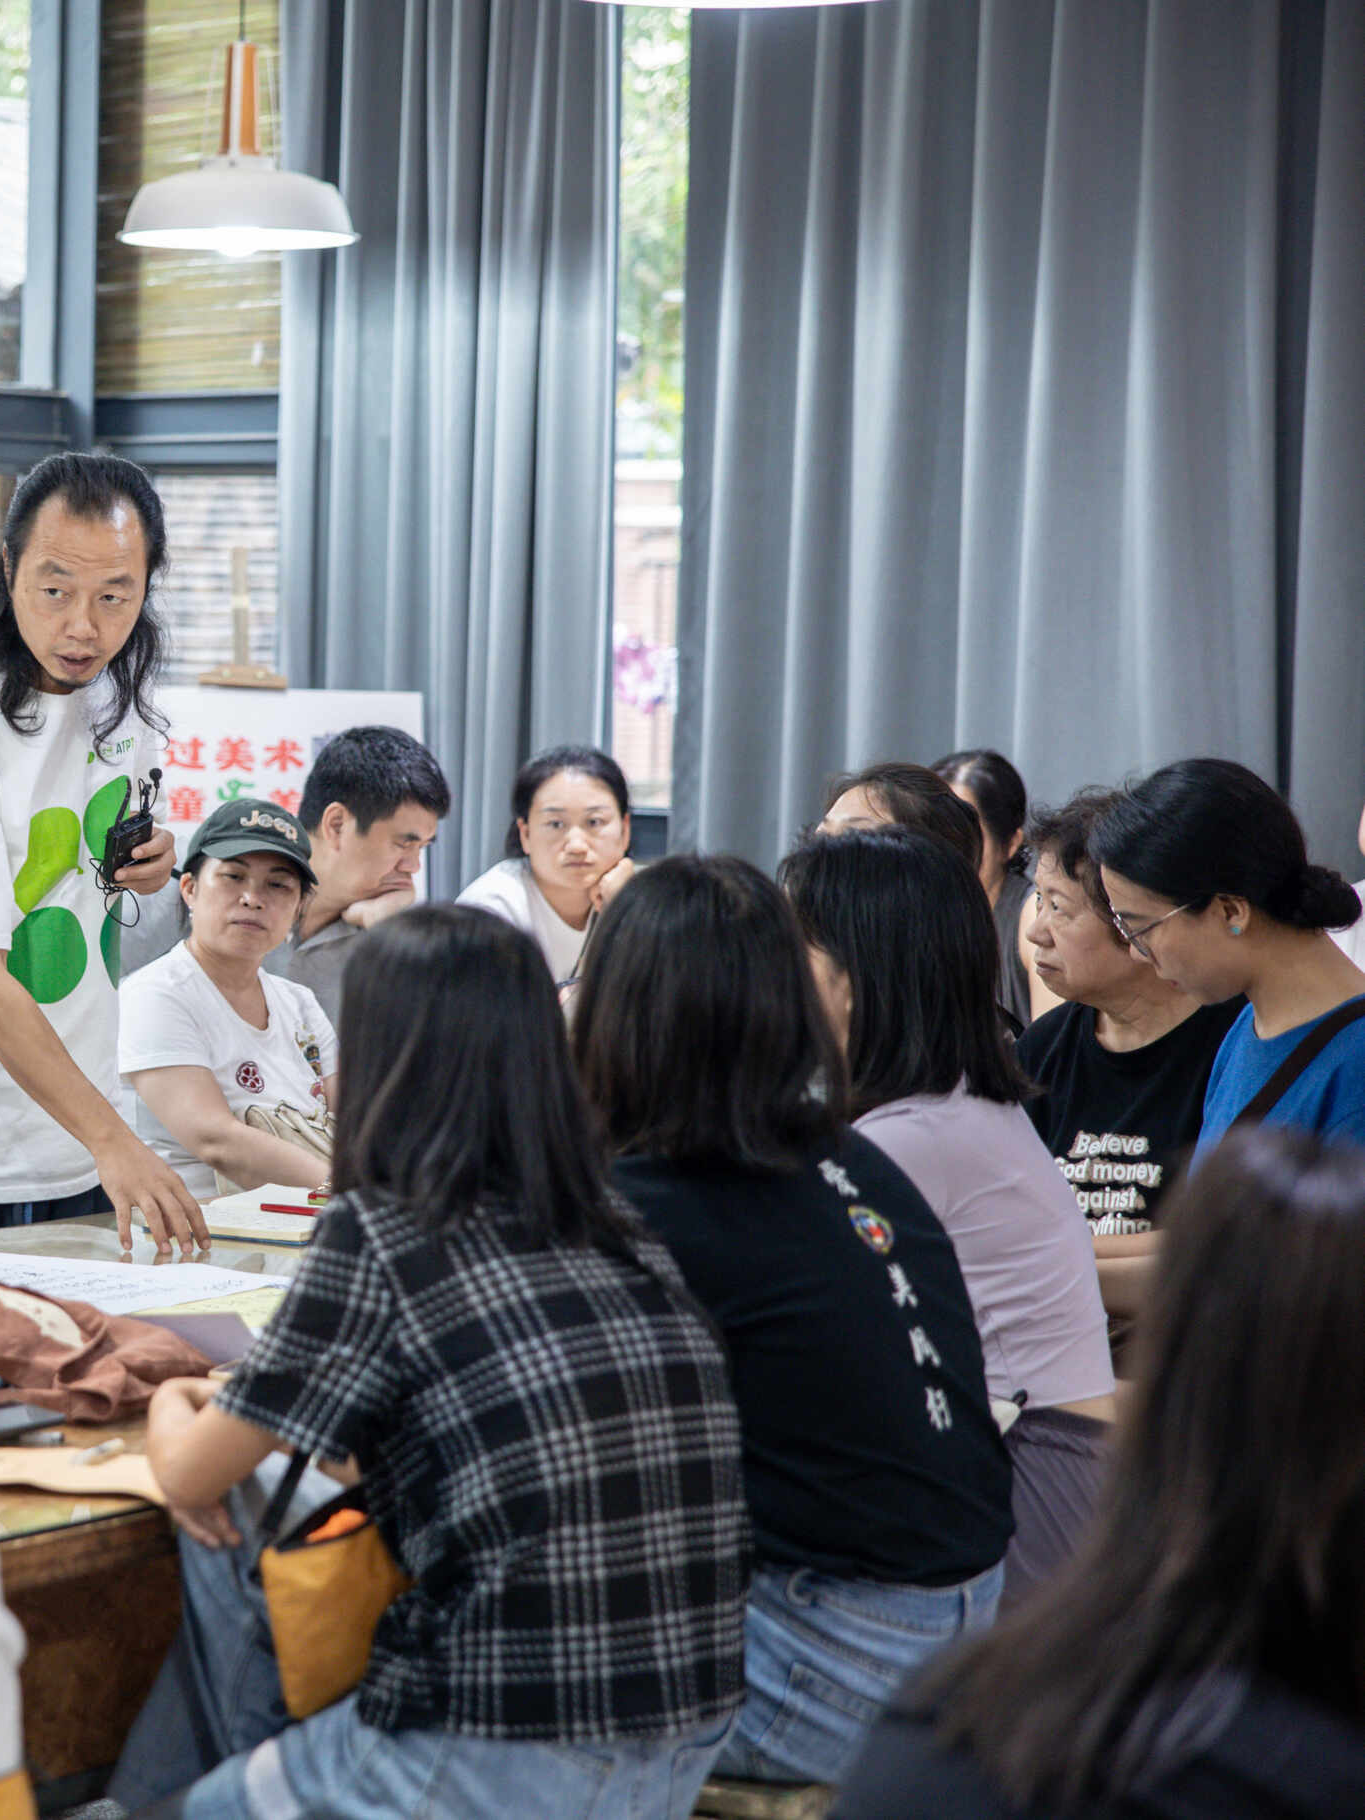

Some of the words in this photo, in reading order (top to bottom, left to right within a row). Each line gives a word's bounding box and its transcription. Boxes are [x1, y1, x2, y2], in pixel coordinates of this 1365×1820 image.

[165, 736, 304, 773] 过美术
[1092, 1163, 1162, 1185] money
[1070, 1185, 1137, 1212] gainst
